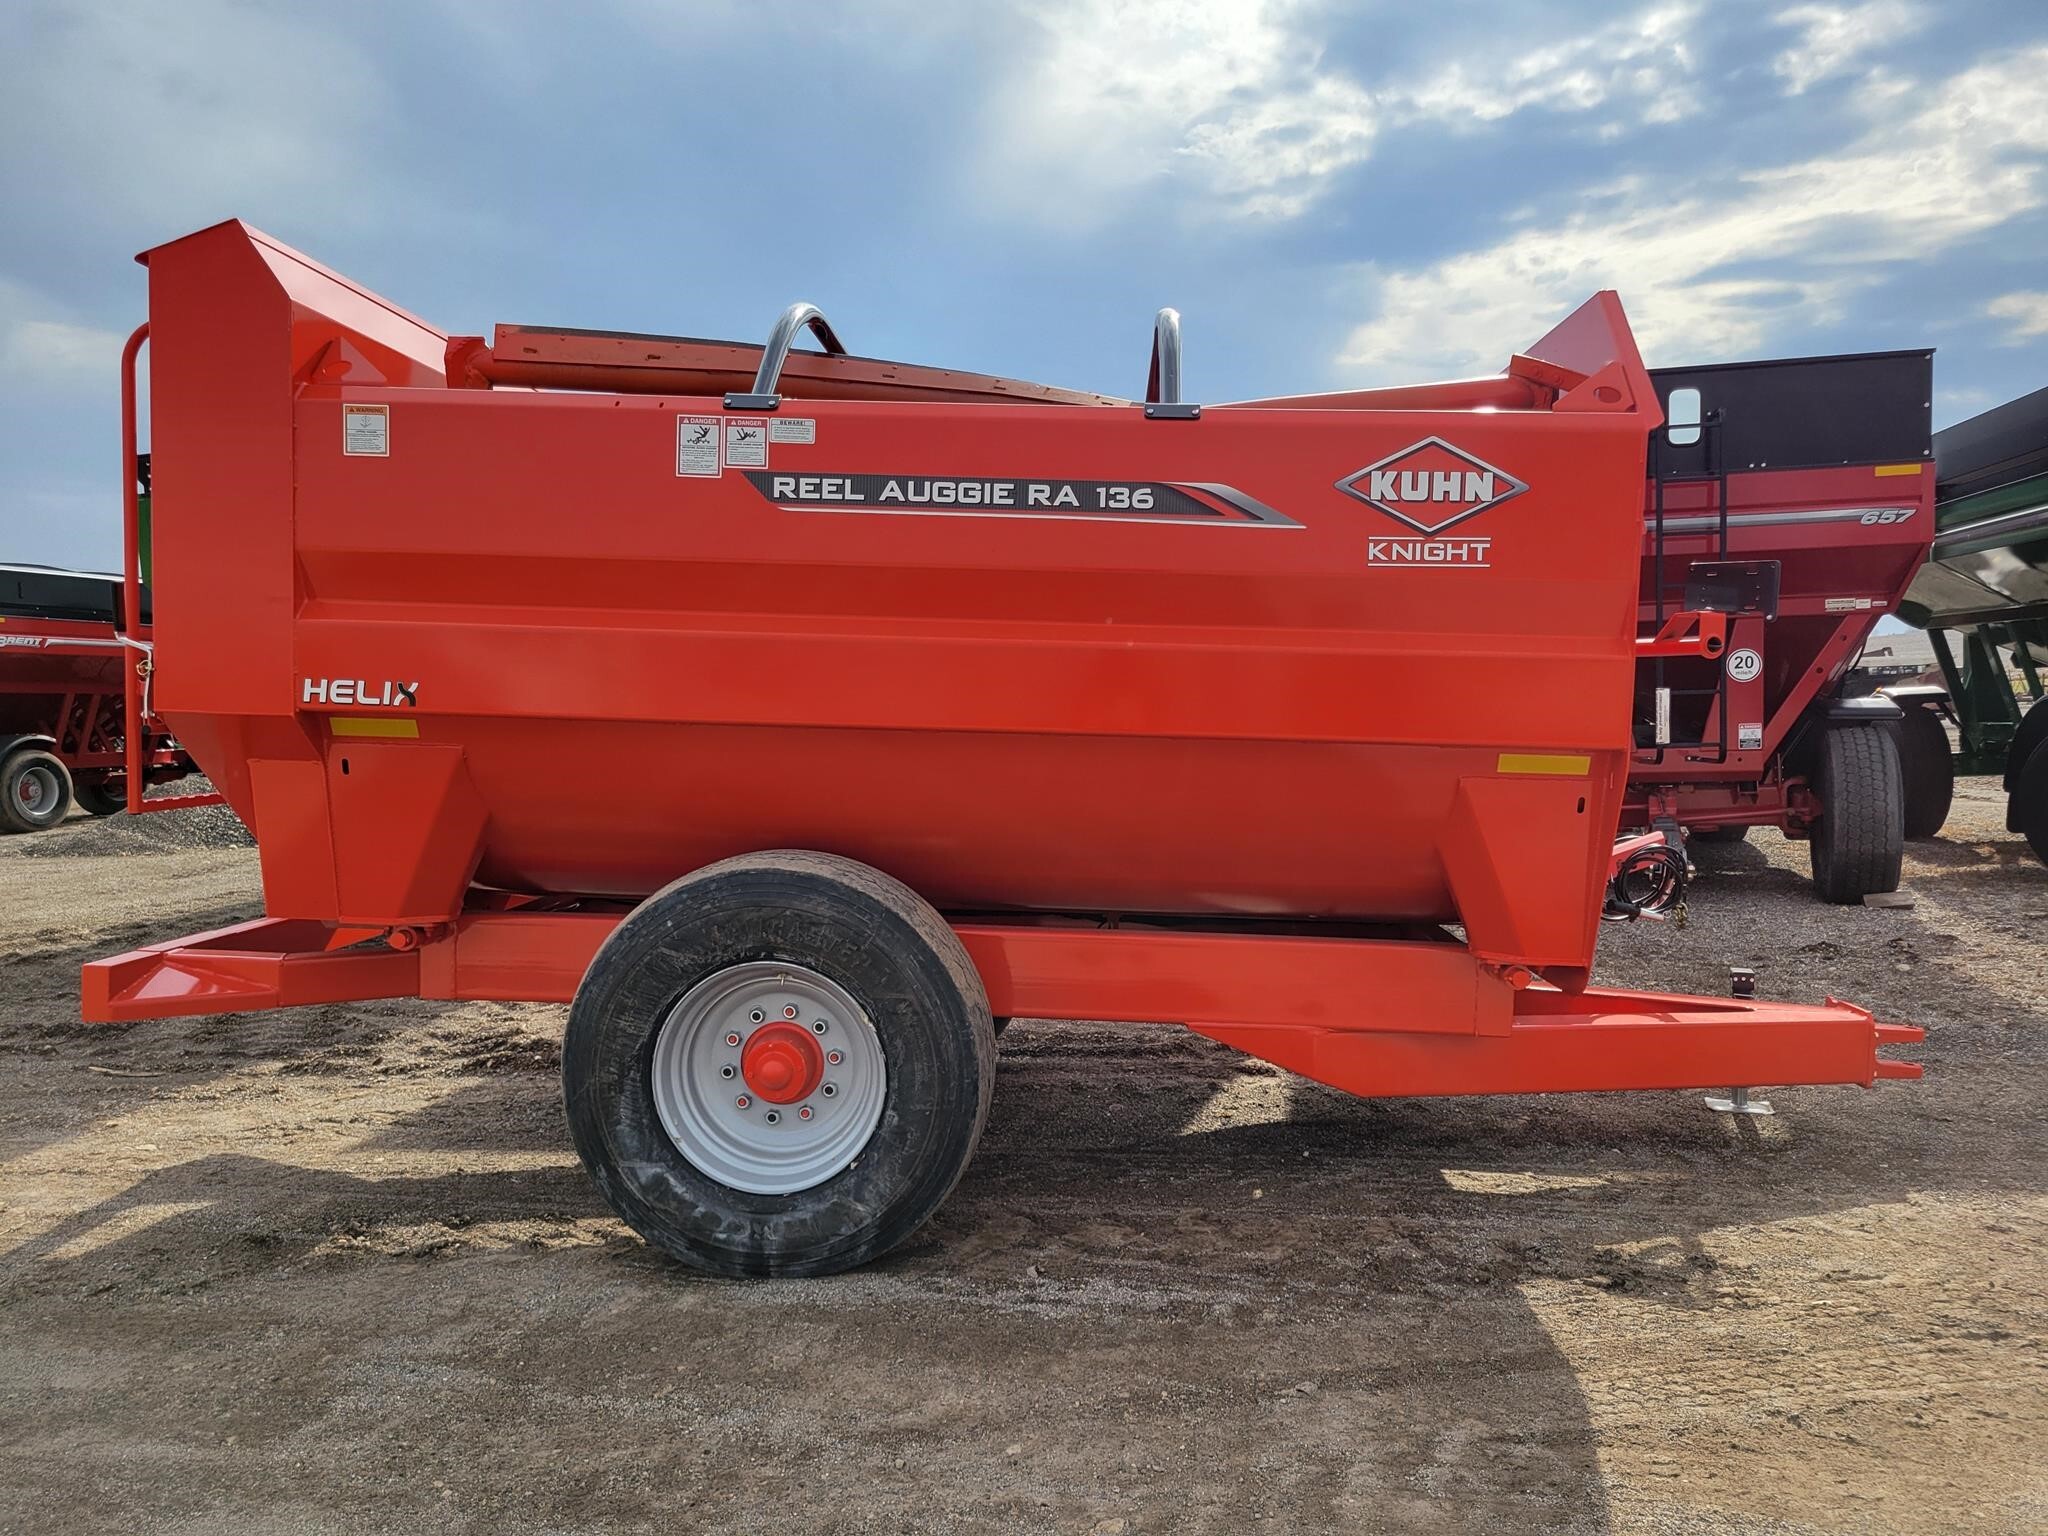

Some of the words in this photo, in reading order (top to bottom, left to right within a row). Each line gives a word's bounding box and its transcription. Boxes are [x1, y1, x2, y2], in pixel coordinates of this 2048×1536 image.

[773, 477, 865, 500] REEL
[879, 480, 1015, 505] AUGGIE
[1028, 484, 1080, 507] RA
[1096, 487, 1154, 510] 136
[1370, 470, 1494, 502] KUHN
[1861, 509, 1917, 525] 657
[1368, 542, 1491, 562] KNIGHT
[1734, 656, 1754, 669] 20
[303, 678, 419, 707] HELIX
